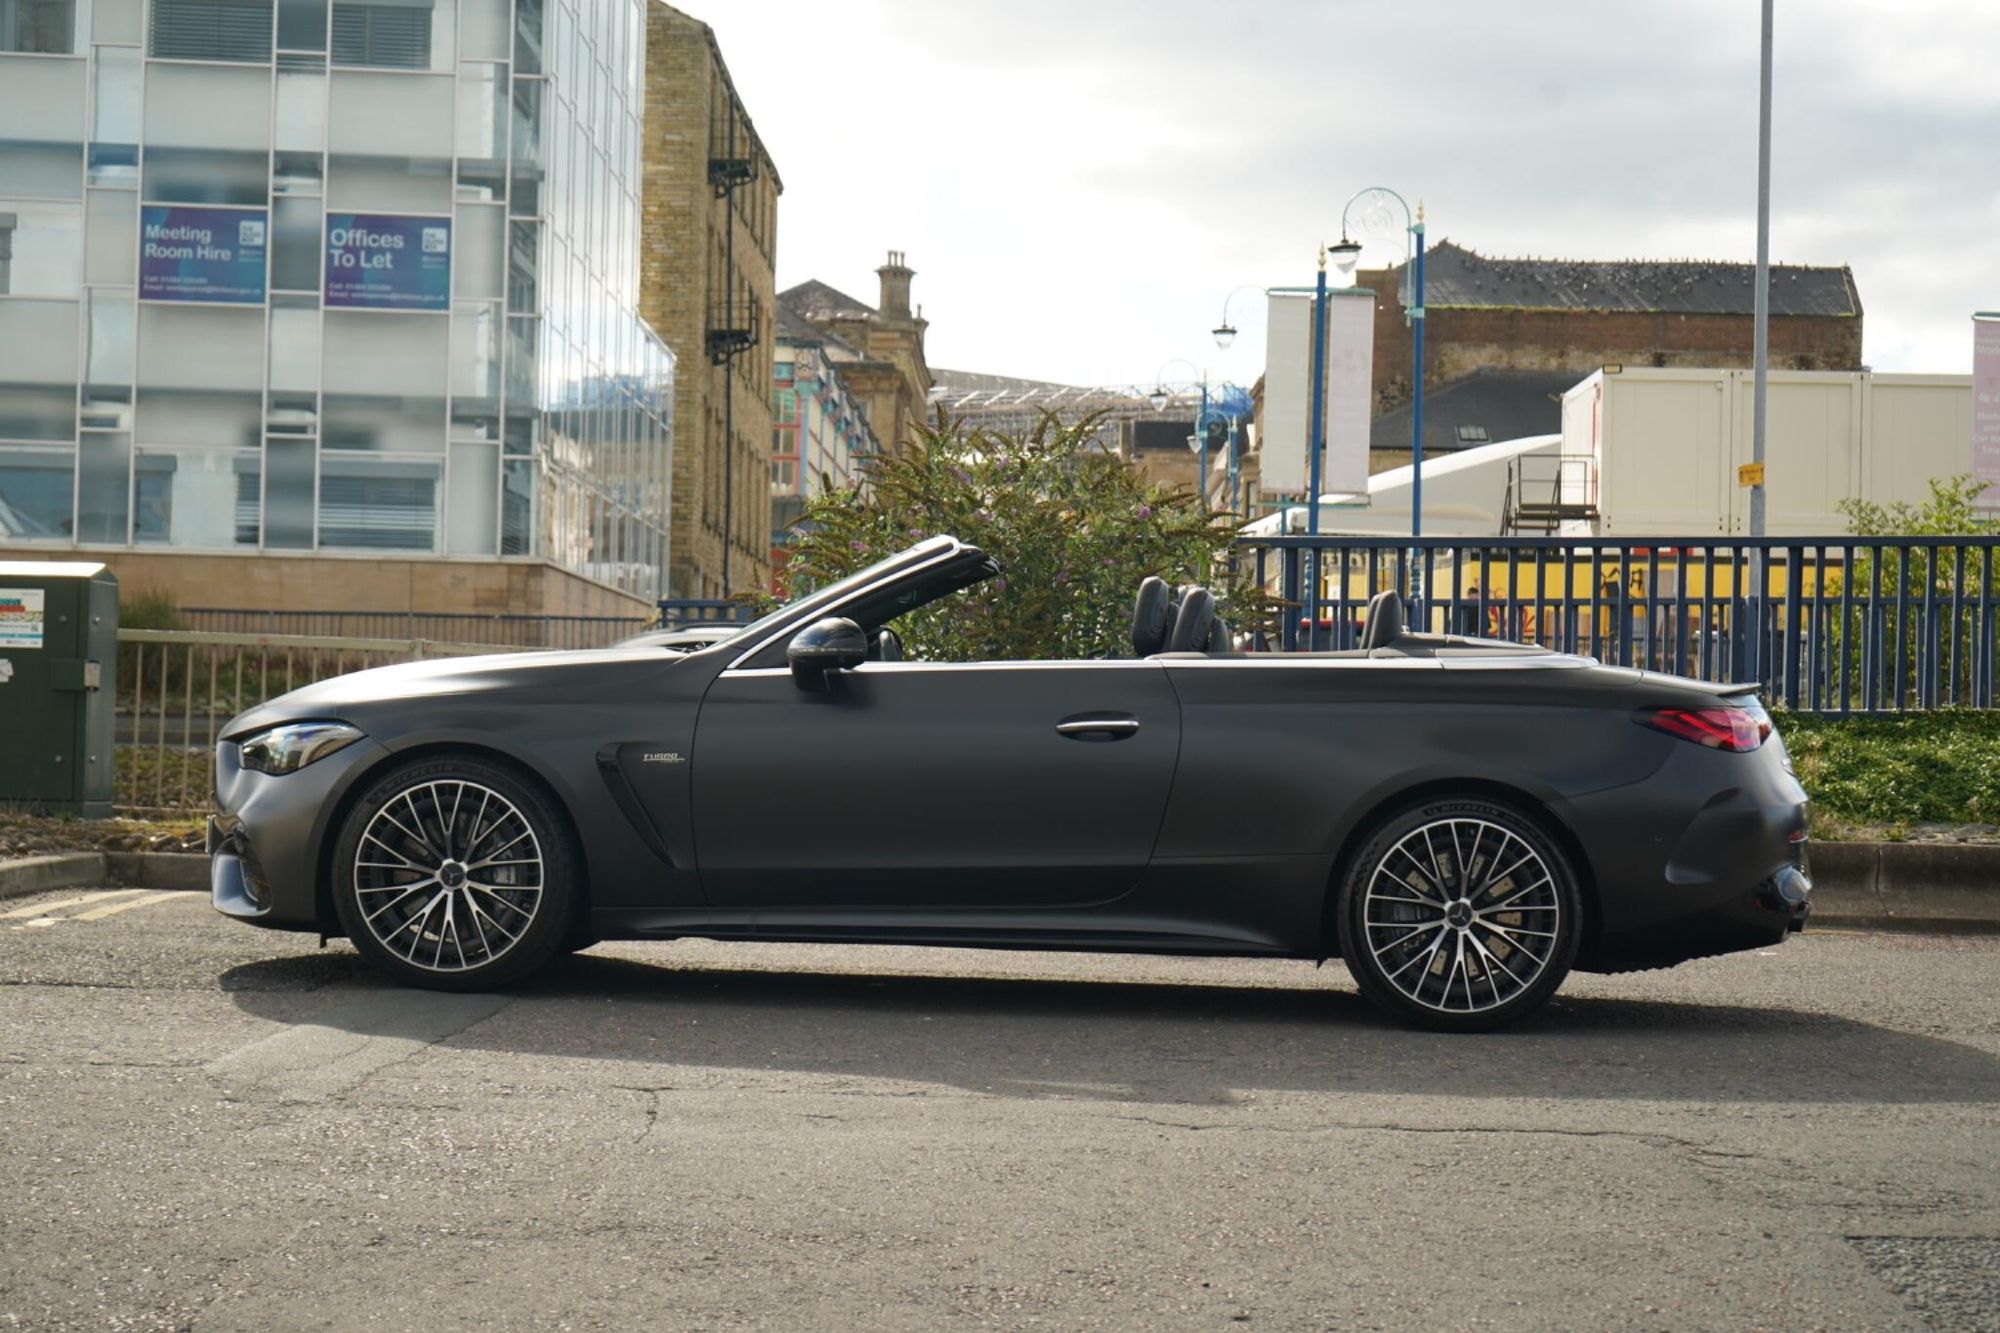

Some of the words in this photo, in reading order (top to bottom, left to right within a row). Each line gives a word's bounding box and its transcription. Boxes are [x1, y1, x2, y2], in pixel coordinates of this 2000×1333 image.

[145, 224, 212, 244] Meeting
[330, 228, 405, 248] Offices
[145, 243, 193, 259] Room
[197, 245, 232, 261] Hire
[329, 249, 355, 267] To
[359, 250, 393, 268] Let
